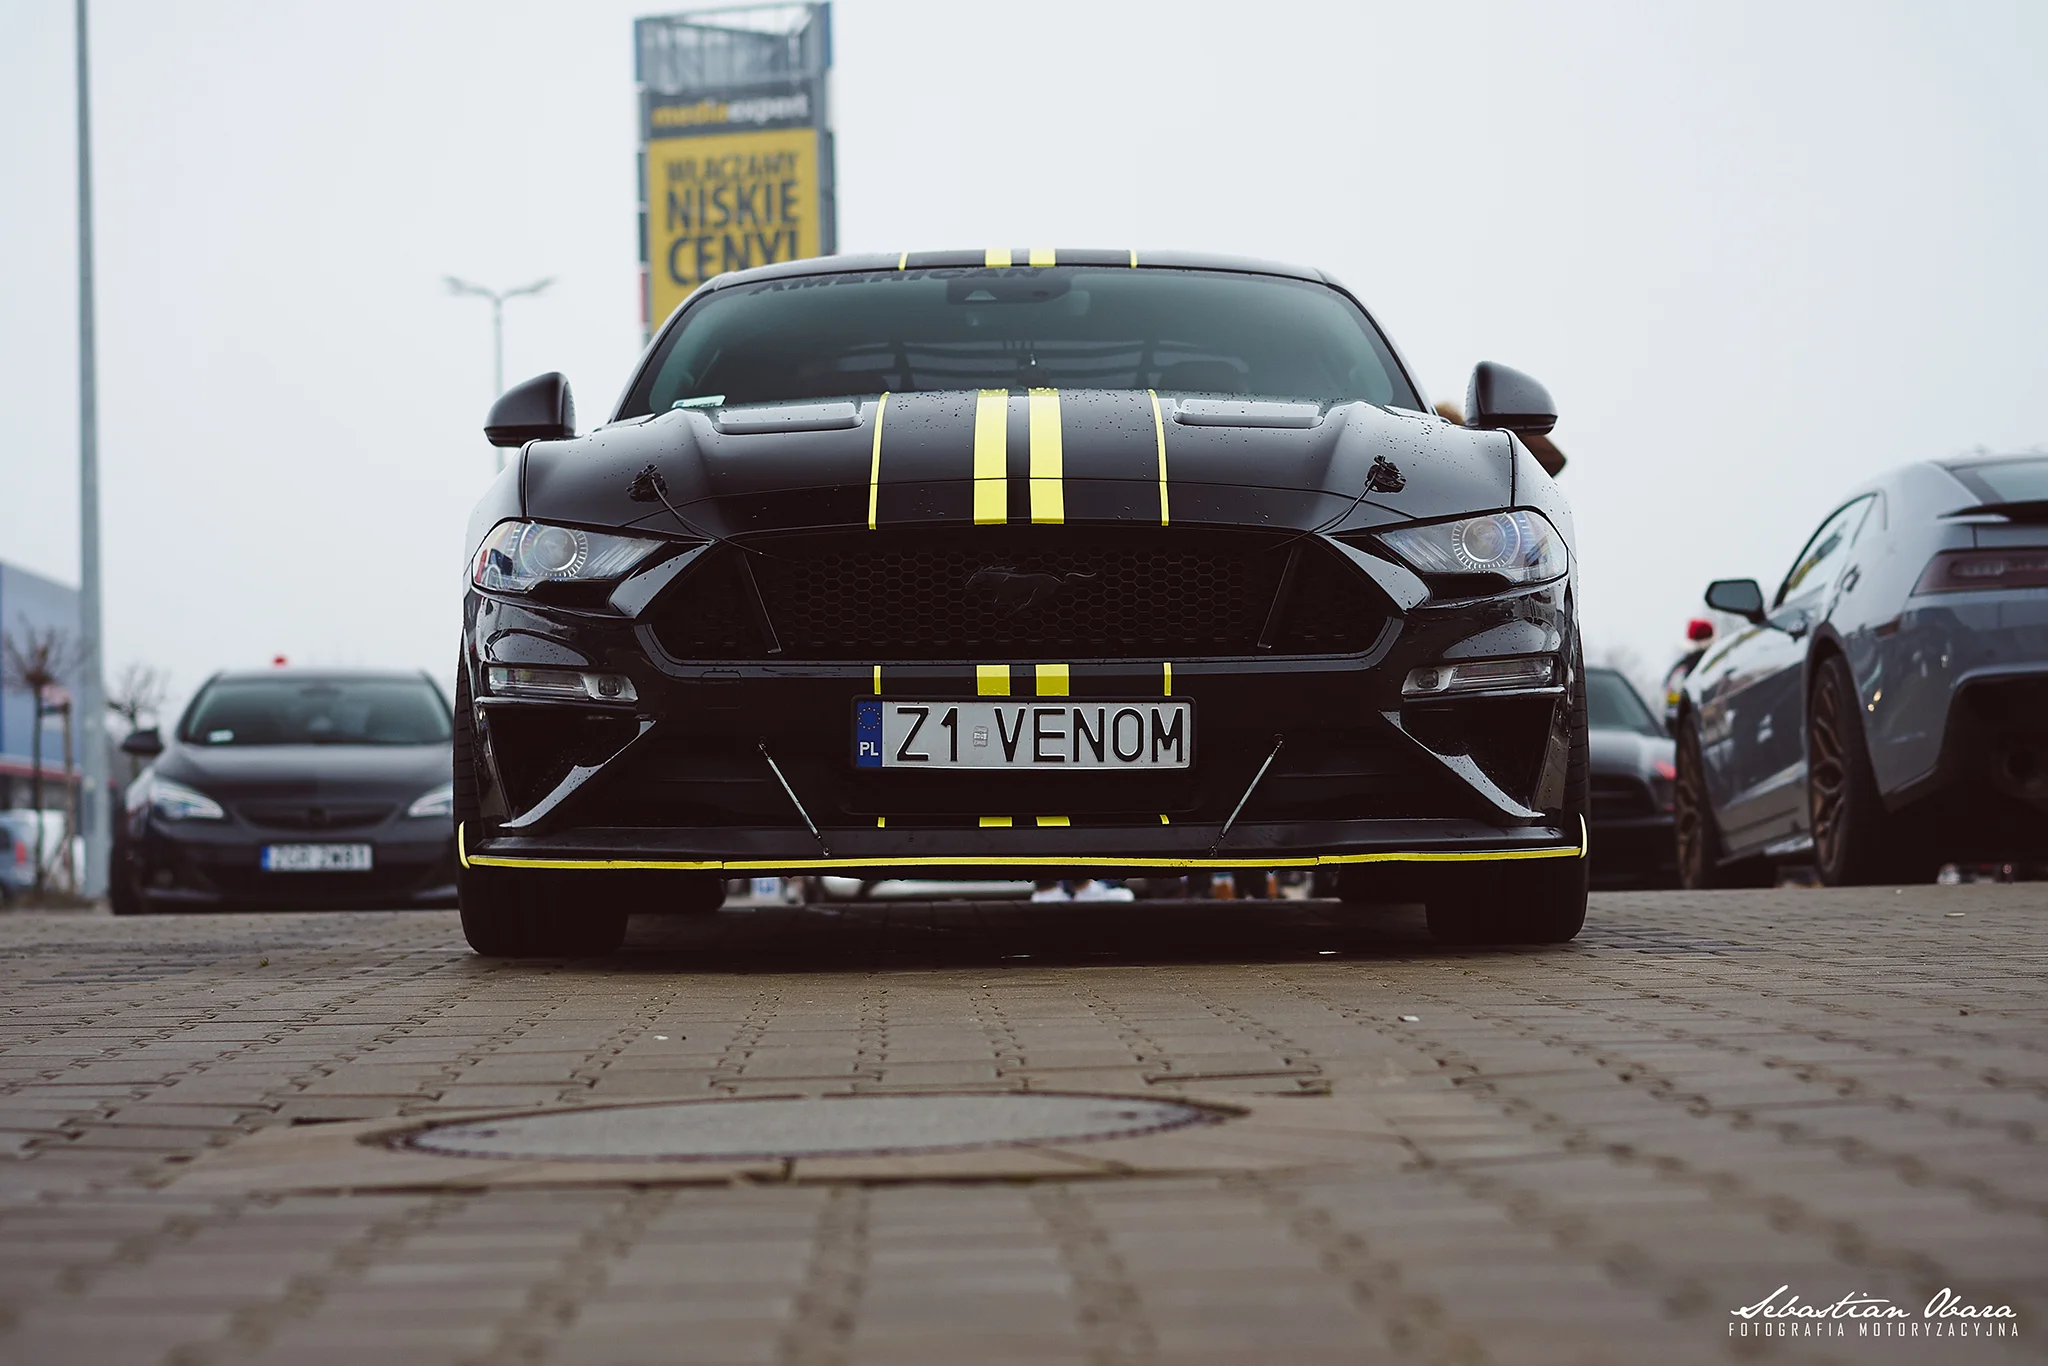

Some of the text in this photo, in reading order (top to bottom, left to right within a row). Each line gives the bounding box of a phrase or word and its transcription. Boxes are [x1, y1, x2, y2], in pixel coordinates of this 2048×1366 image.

[666, 181, 799, 231] NISKIE
[859, 741, 879, 757] PL
[896, 706, 1184, 763] Z1 VENOM
